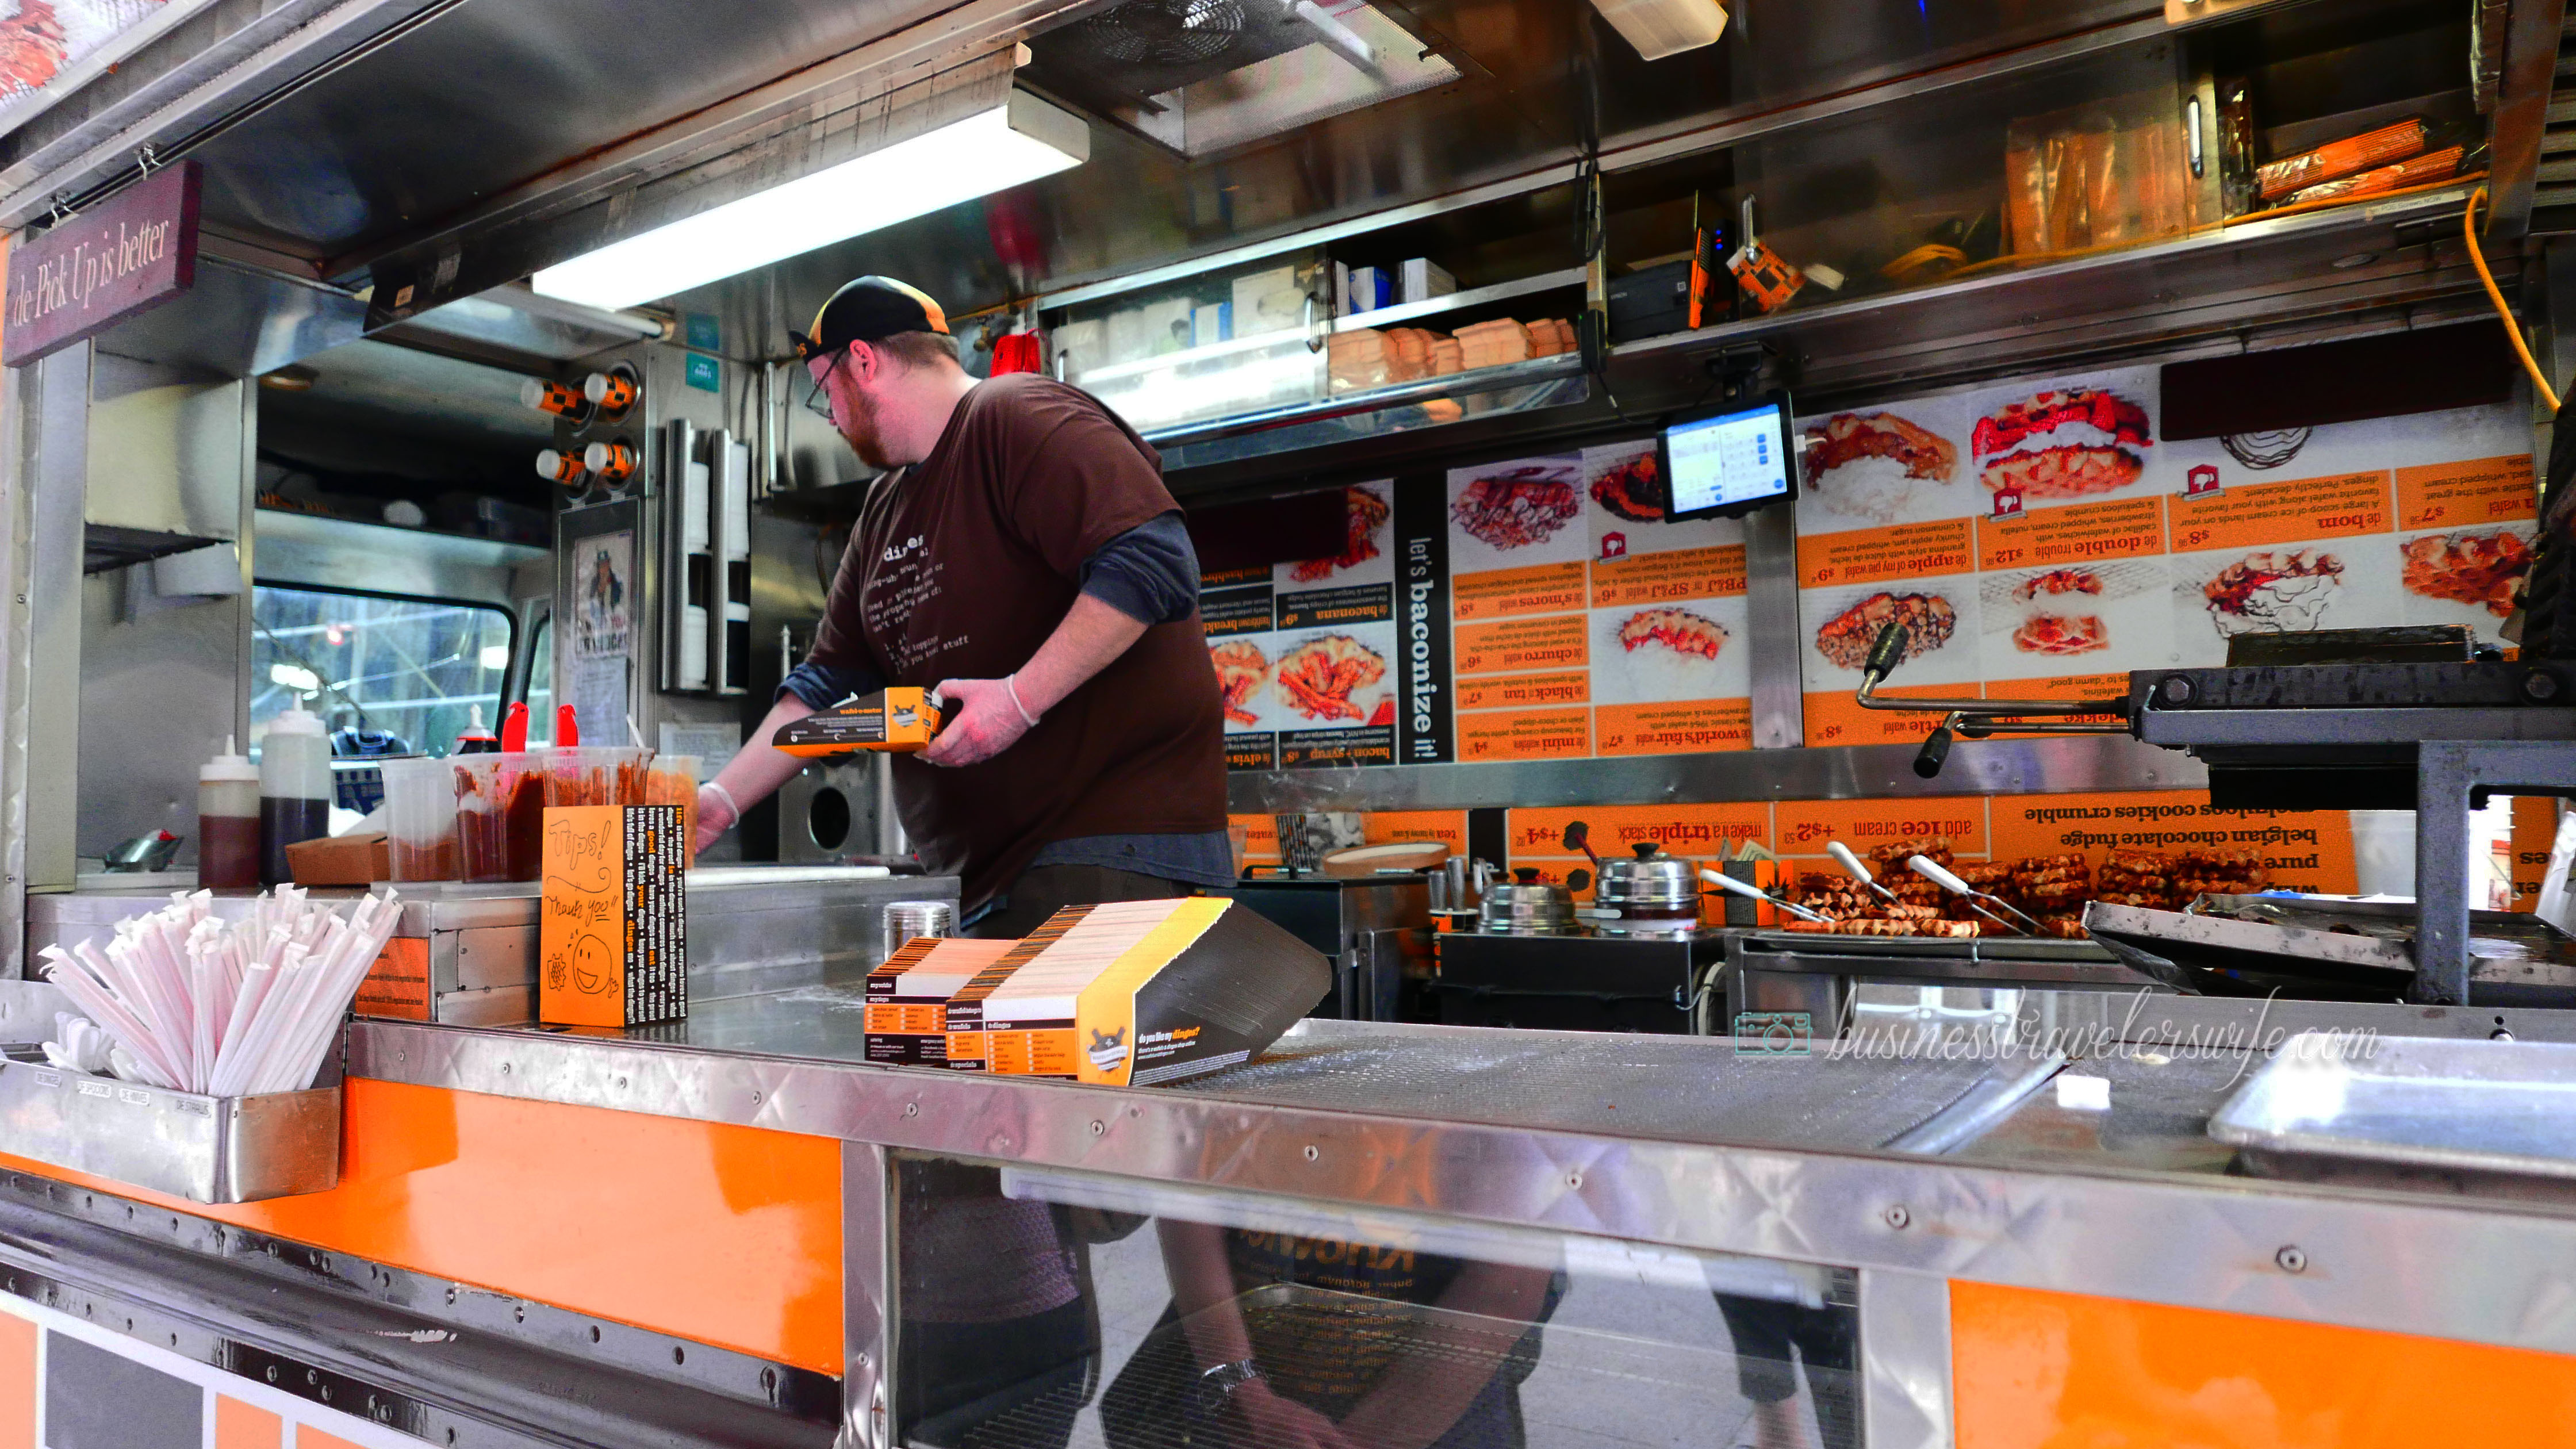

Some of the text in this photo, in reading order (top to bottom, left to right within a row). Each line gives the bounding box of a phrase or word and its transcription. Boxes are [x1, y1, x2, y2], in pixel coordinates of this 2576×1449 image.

[14, 220, 168, 327] de Pick Up is better
[2295, 480, 2339, 494] Perfectly
[2424, 473, 2506, 488] whipped cream
[2424, 486, 2500, 500] with the great
[2191, 488, 2379, 515] favorite wafel along with your favorite
[2310, 501, 2340, 513] scoop
[2343, 500, 2368, 511] large
[2487, 500, 2521, 515] wafel
[2065, 507, 2100, 518] crumble
[2247, 510, 2278, 520] cream
[2296, 508, 2307, 516] of
[2000, 518, 2097, 535] whipped nutella
[2179, 516, 2201, 527] your
[2203, 516, 2215, 524] on
[2317, 512, 2381, 530] de bom
[1915, 524, 1956, 534] cinnamon
[2123, 524, 2157, 534] cadillac
[1856, 533, 1965, 551] chunky apple whipped
[2036, 534, 2056, 542] with
[2144, 535, 2157, 549] de
[1908, 547, 1927, 557] style
[1929, 543, 1965, 553] grandma
[2035, 543, 2071, 559] trouble
[2075, 537, 2141, 555] double
[1865, 552, 1887, 561] dulce
[1888, 550, 1906, 559] with
[1845, 554, 1966, 578] de apple of my pie wafel
[1519, 595, 1572, 607] s'mores
[1316, 605, 1378, 619] baconana
[1409, 538, 1438, 758] let's baconize it!
[1524, 649, 1572, 662] churro
[2107, 676, 2117, 684] to
[1504, 689, 1526, 700] tan
[1536, 687, 1573, 700] black
[1883, 720, 1942, 735] rtle wafel
[1657, 733, 1682, 746] fair
[1685, 730, 1740, 744] world's
[1542, 738, 1574, 751] mini
[1233, 754, 1261, 766] elvis
[1310, 746, 1345, 760] syrup
[1354, 747, 1390, 759] bacon
[2025, 805, 2197, 824] cookies crumble
[1436, 829, 1457, 839] tea
[1617, 822, 1762, 844] make triple stack
[1854, 822, 1897, 838] cream
[1902, 821, 1941, 837] ice
[1945, 820, 1972, 839] add
[637, 833, 645, 853] dinges
[647, 830, 656, 853] good
[2060, 826, 2318, 849] belgian chocolate fudge
[549, 819, 611, 871] Tips!
[626, 841, 634, 861] dinges
[647, 854, 656, 876] dinges
[2264, 853, 2320, 870] pure
[668, 865, 674, 874] is
[545, 895, 584, 919] Thank
[626, 920, 635, 952] dinges
[1172, 1026, 1200, 1039] dinges?
[178, 1100, 185, 1110] DE
